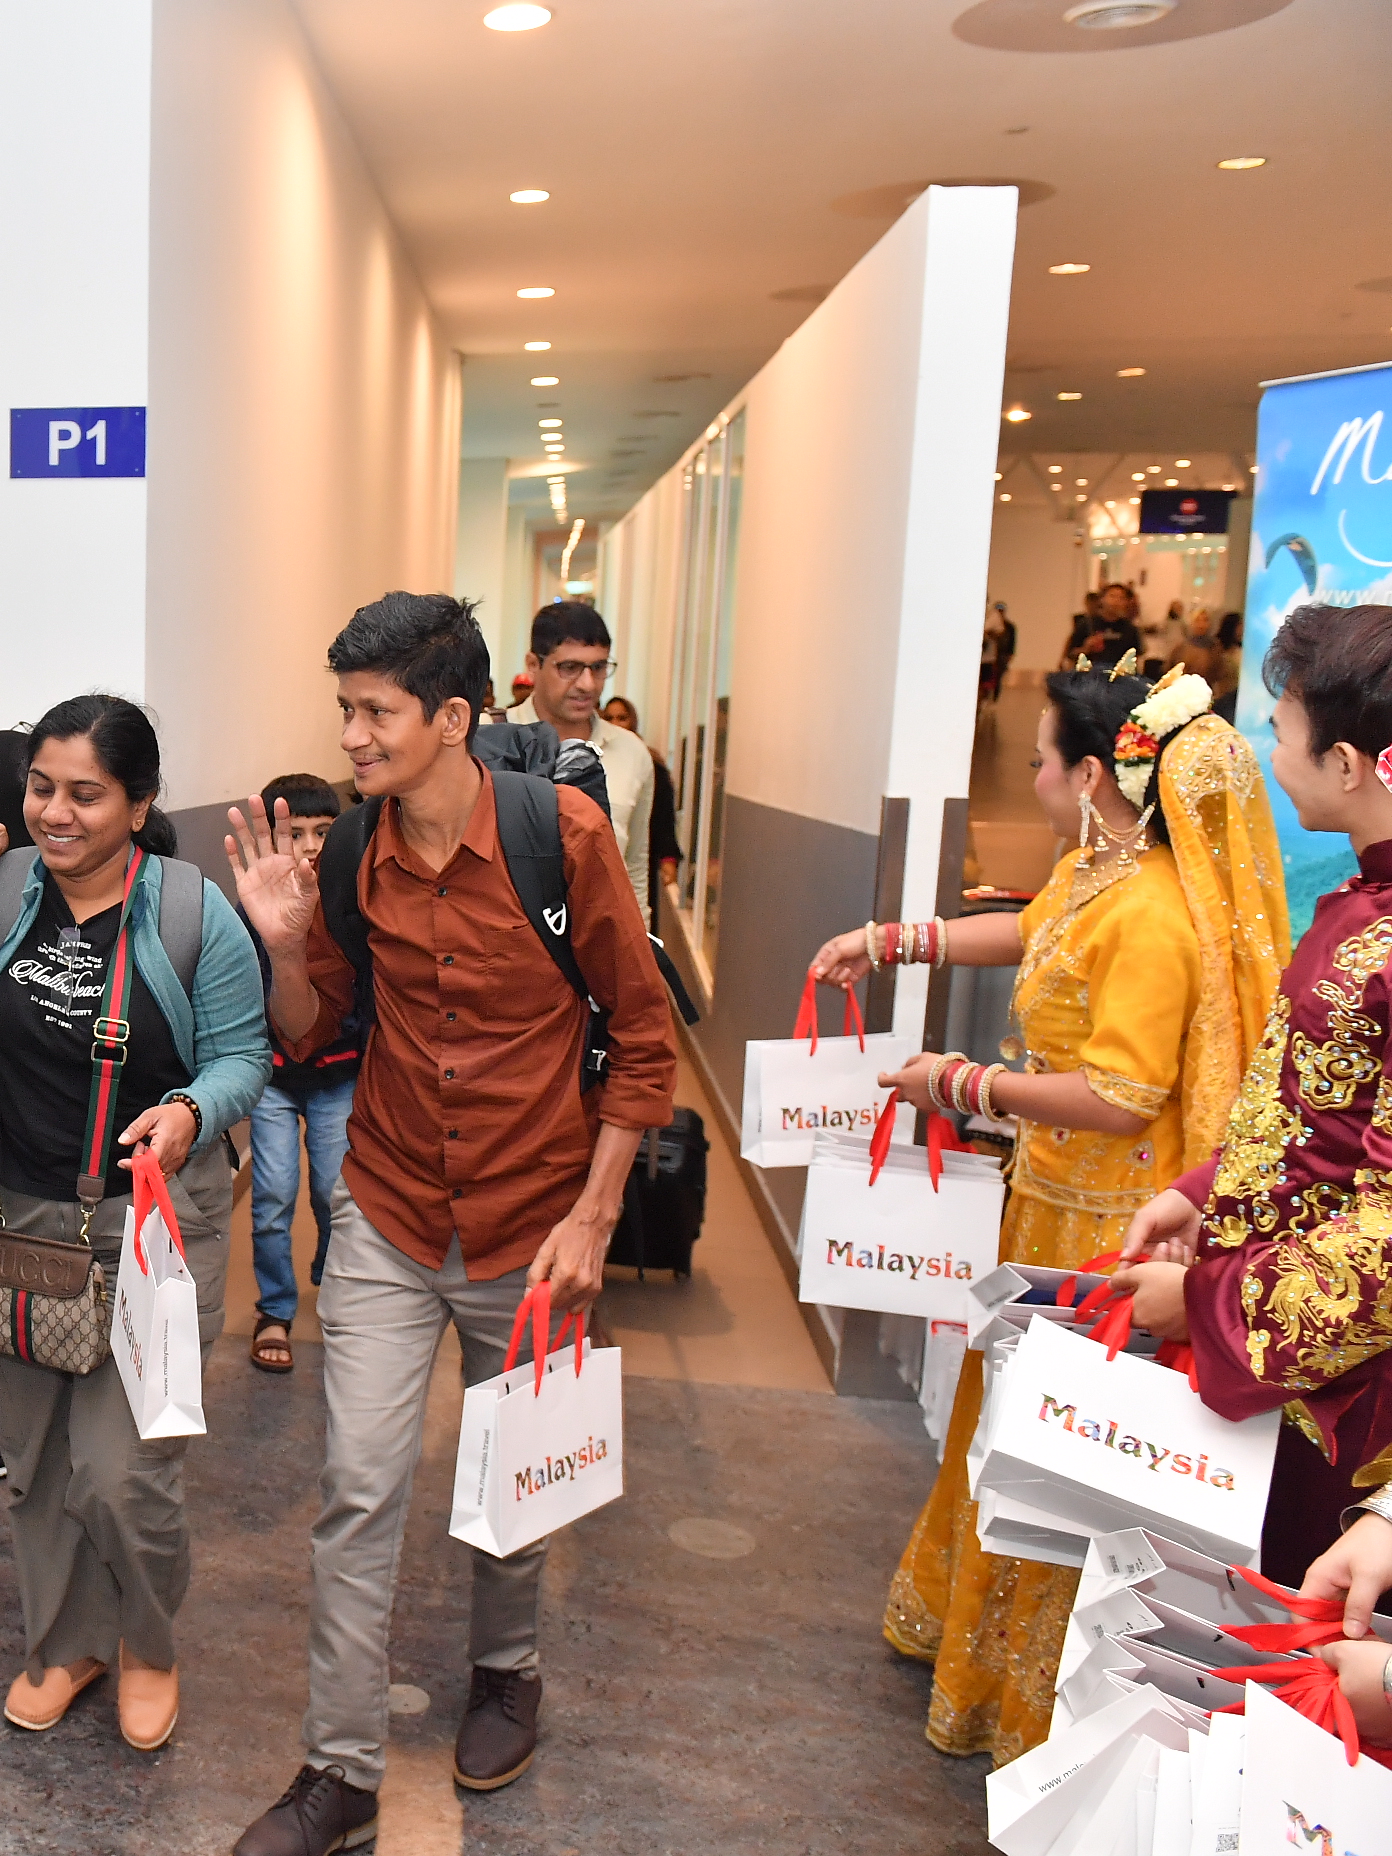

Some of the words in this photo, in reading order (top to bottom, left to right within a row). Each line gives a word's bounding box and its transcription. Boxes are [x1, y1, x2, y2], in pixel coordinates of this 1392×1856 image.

[49, 420, 106, 466] P1
[39, 1000, 68, 1016] ANGELE
[781, 1102, 881, 1132] Malaysi
[826, 1238, 974, 1281] Malaysia
[1038, 1393, 1236, 1491] Malaysia
[514, 1435, 608, 1502] Malaysia
